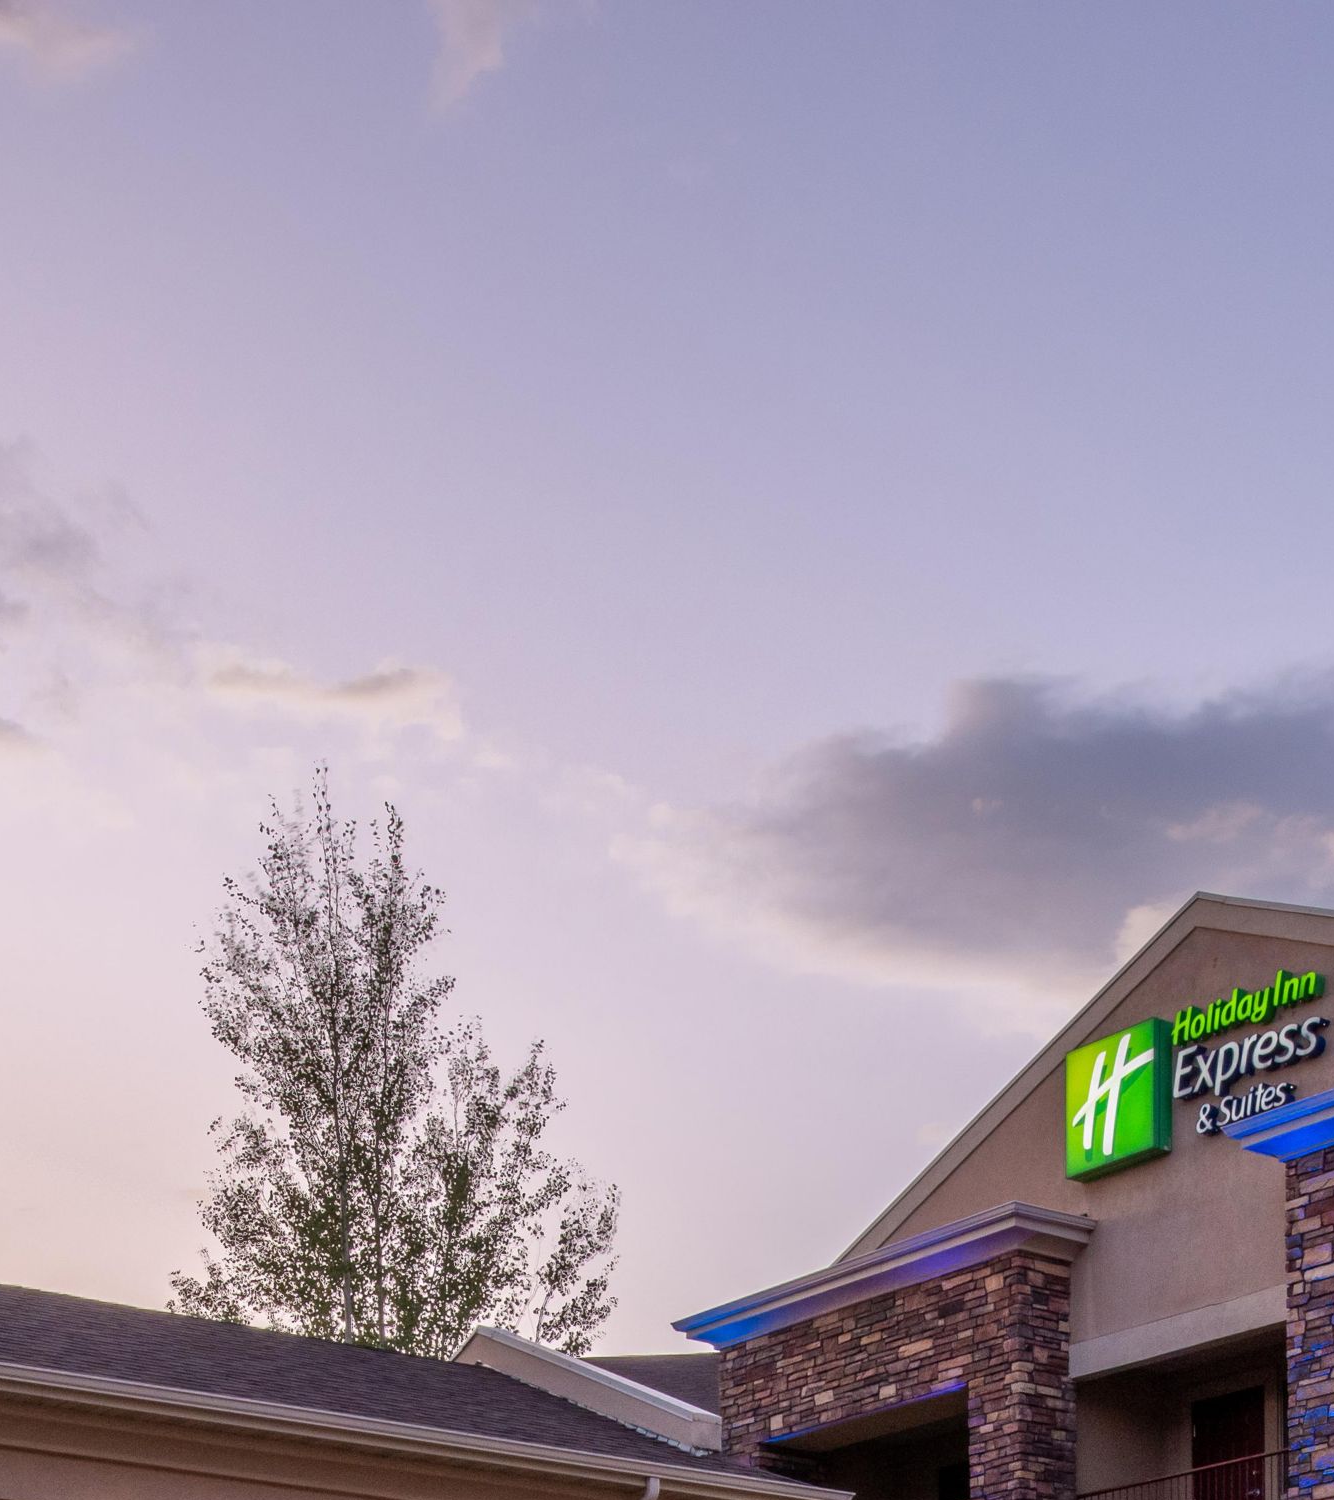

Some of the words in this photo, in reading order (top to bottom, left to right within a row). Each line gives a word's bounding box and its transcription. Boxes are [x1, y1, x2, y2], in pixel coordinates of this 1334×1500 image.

[1171, 986, 1271, 1046] Holiday
[1273, 969, 1318, 1007] Inn
[1172, 1016, 1323, 1099] Express
[1195, 1103, 1213, 1134] &
[1215, 1082, 1289, 1126] Suites
